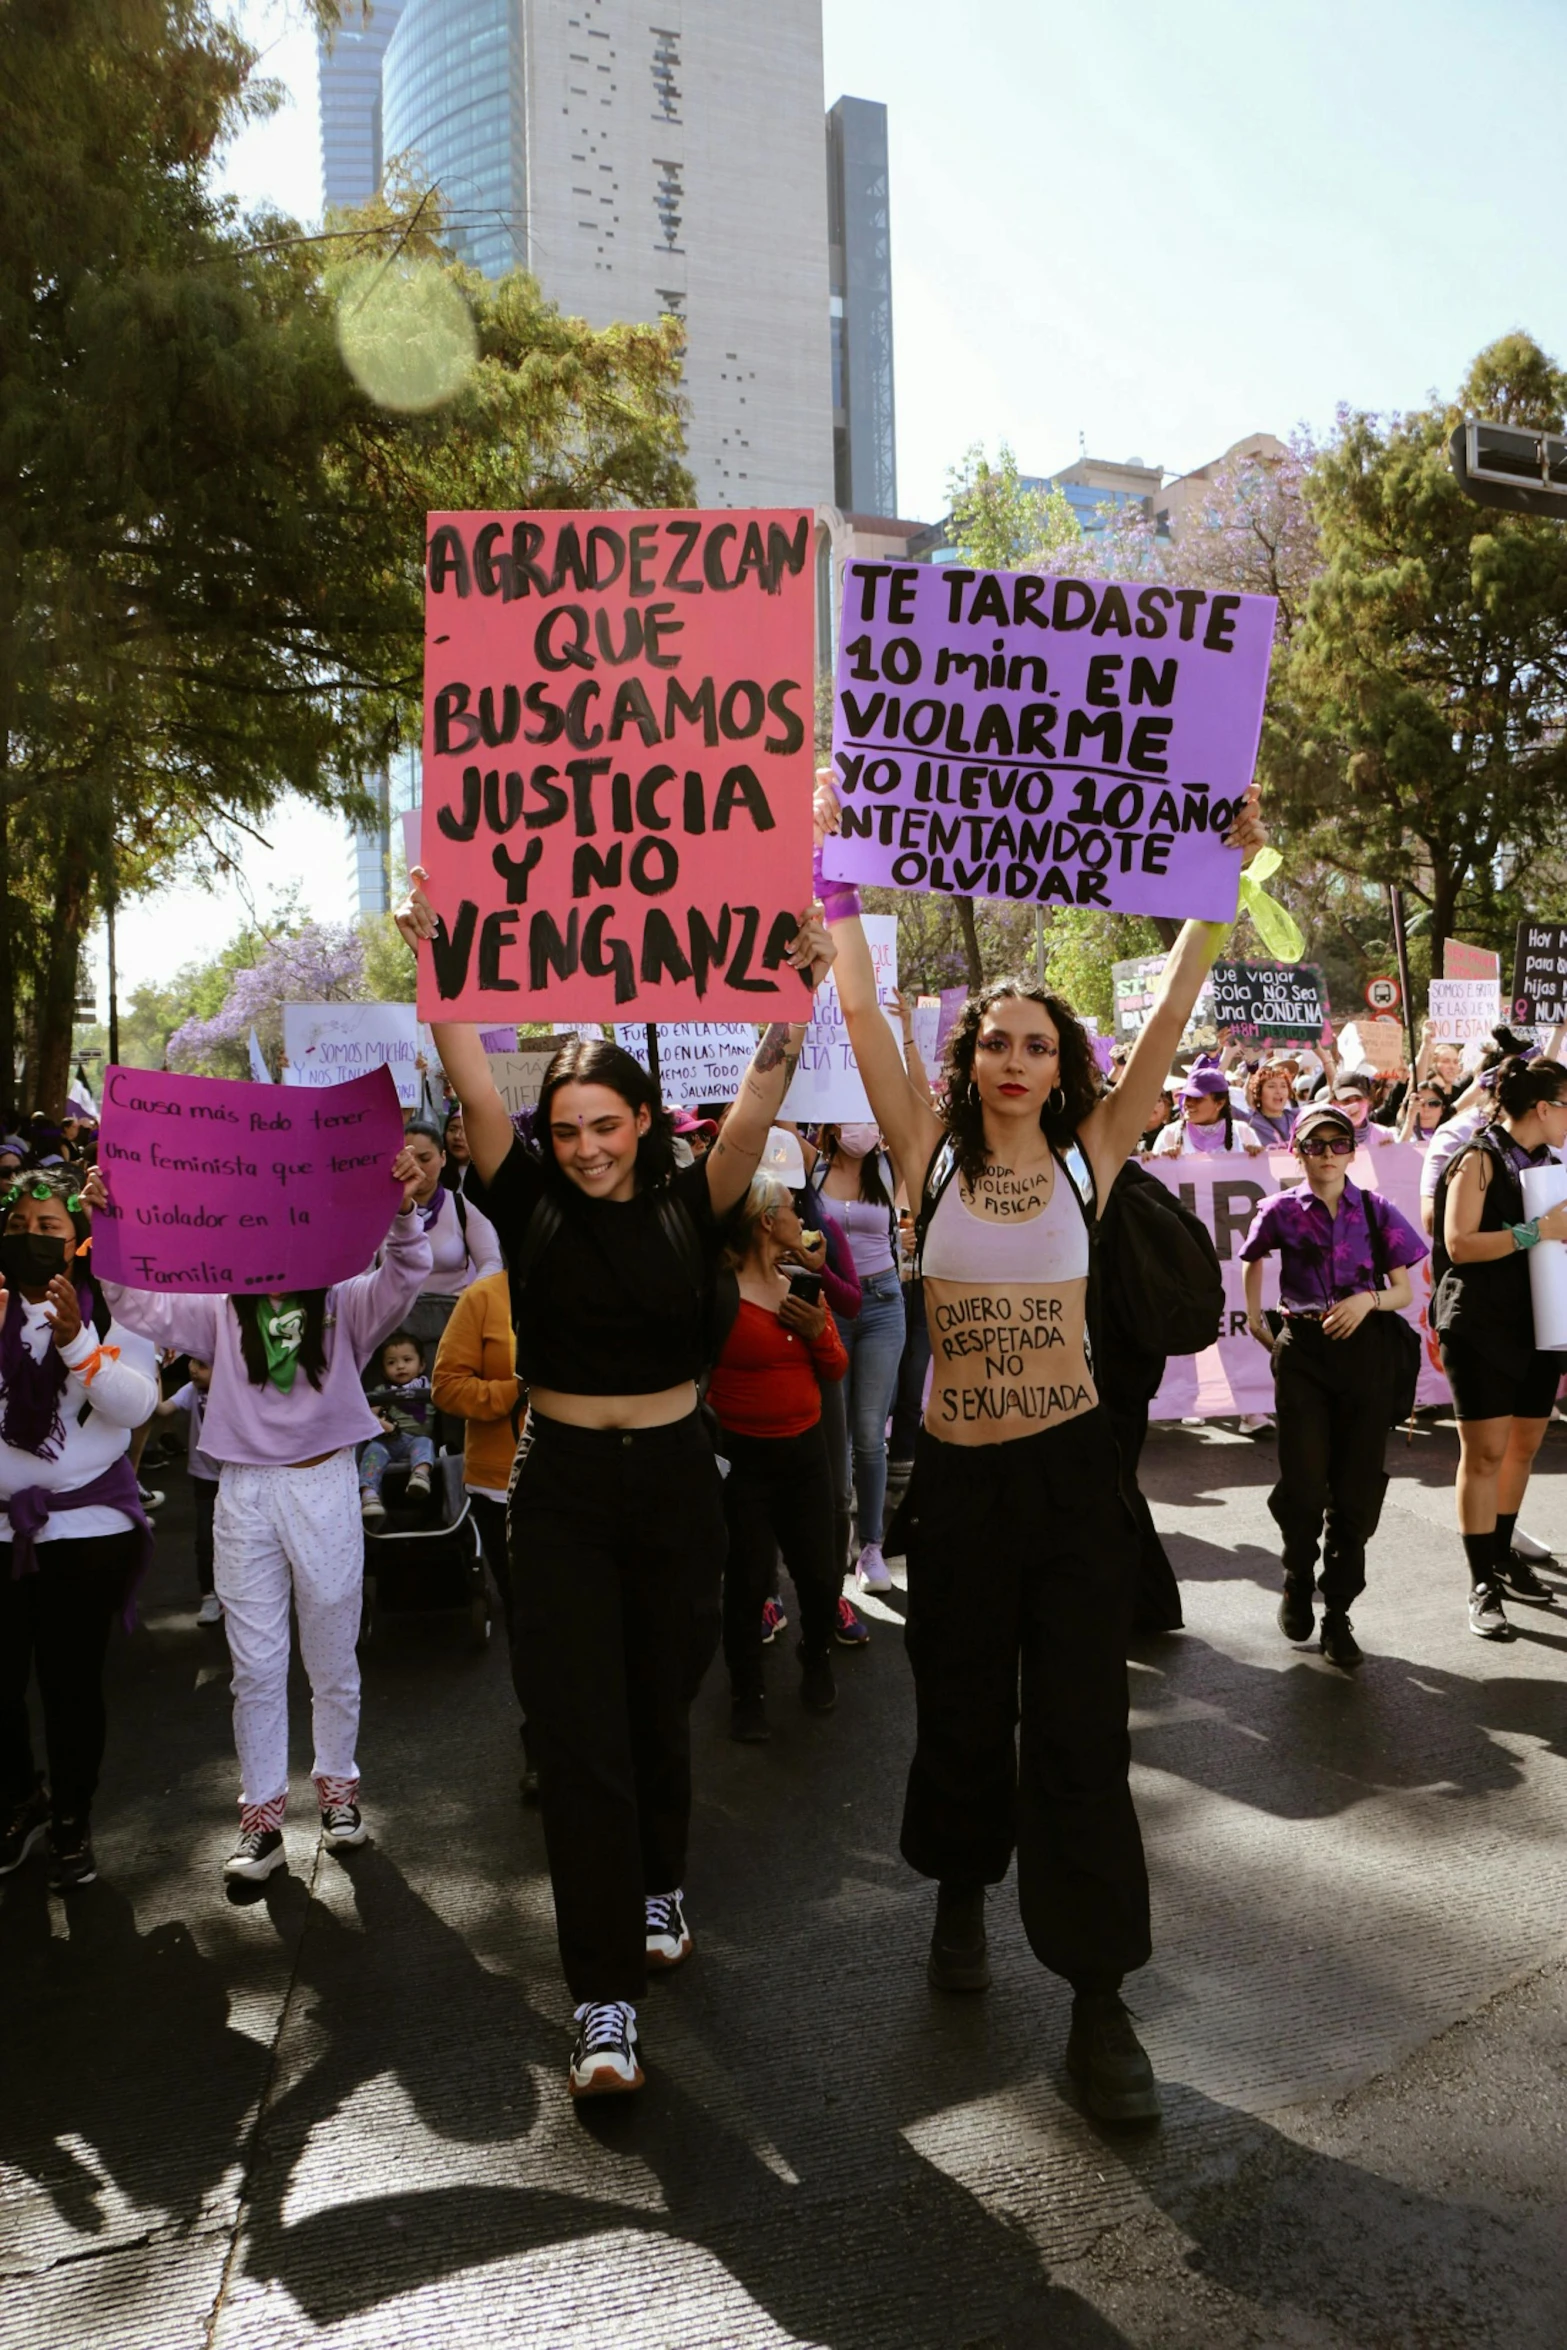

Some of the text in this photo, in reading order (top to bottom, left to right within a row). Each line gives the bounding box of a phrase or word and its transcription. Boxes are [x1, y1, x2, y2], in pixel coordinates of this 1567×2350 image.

[427, 515, 809, 603] AGRADEZCAN
[851, 564, 1242, 654] TE TARDASTE
[533, 602, 686, 672] QUE
[845, 634, 1179, 709] 10 min. EN
[433, 675, 806, 757] BUSCAMOS
[840, 688, 1175, 774] VIOLARME
[436, 757, 777, 841] JUSTICIA
[834, 751, 902, 795] YO
[1067, 777, 1145, 832] 10
[830, 804, 1176, 876] NTENTANDOTE
[492, 834, 680, 905] Y NO
[891, 852, 1113, 908] OLVIDAR
[1213, 968, 1296, 986] ue viajar
[1263, 985, 1288, 1001] NO
[1432, 983, 1465, 999] SOMOS
[1523, 976, 1557, 1001] hijas
[1250, 1002, 1324, 1023] CONDENA
[1447, 1002, 1467, 1017] LAS
[620, 1024, 669, 1042] FUEO
[674, 1023, 691, 1037] EN
[695, 1023, 712, 1036] LA
[319, 1040, 416, 1065] SOMOS MUCHAS
[675, 1045, 692, 1062] EN
[694, 1044, 716, 1060] LAS
[719, 1044, 755, 1058] MANO
[309, 1068, 333, 1086] NOS
[703, 1063, 739, 1079] TODO
[108, 1073, 182, 1117] Causa
[189, 1100, 240, 1124] más
[312, 1107, 374, 1131] tener
[150, 1142, 258, 1177] feminista
[272, 1160, 315, 1187] que
[329, 1150, 388, 1174] tener
[986, 1165, 1015, 1179] ODA
[135, 1203, 228, 1229] violador
[237, 1211, 269, 1228] en
[288, 1205, 311, 1227] la
[129, 1254, 235, 1285] Familia
[935, 1297, 1064, 1333] QUIERO SER
[941, 1325, 1066, 1362] RESPETADA
[985, 1353, 1024, 1380] NO
[940, 1383, 1093, 1422] SEXUALIZADA
